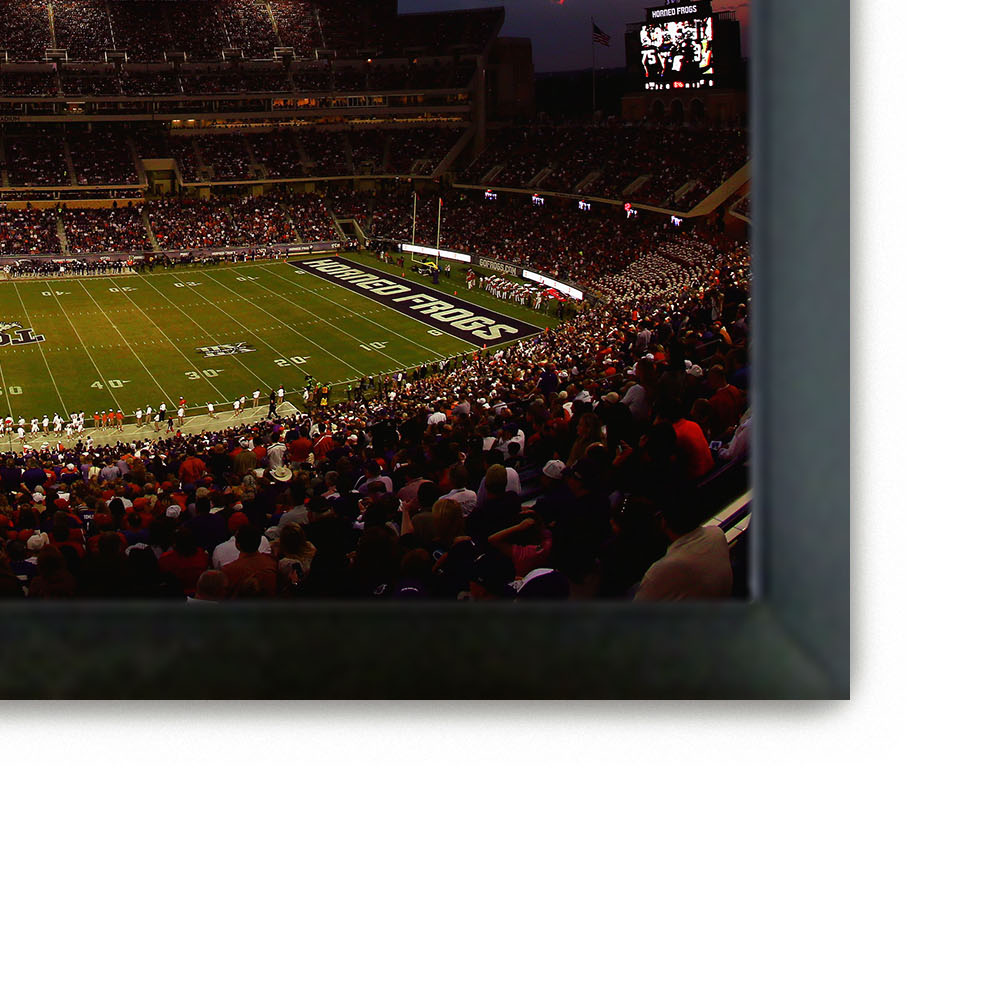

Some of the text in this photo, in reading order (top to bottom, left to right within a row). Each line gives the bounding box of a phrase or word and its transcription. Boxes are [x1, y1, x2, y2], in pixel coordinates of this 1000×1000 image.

[652, 5, 697, 18] HORNED FROGS
[302, 259, 519, 341] HORNED FROGS
[273, 356, 307, 367] 20
[184, 369, 219, 380] 30
[90, 379, 126, 390] 40
